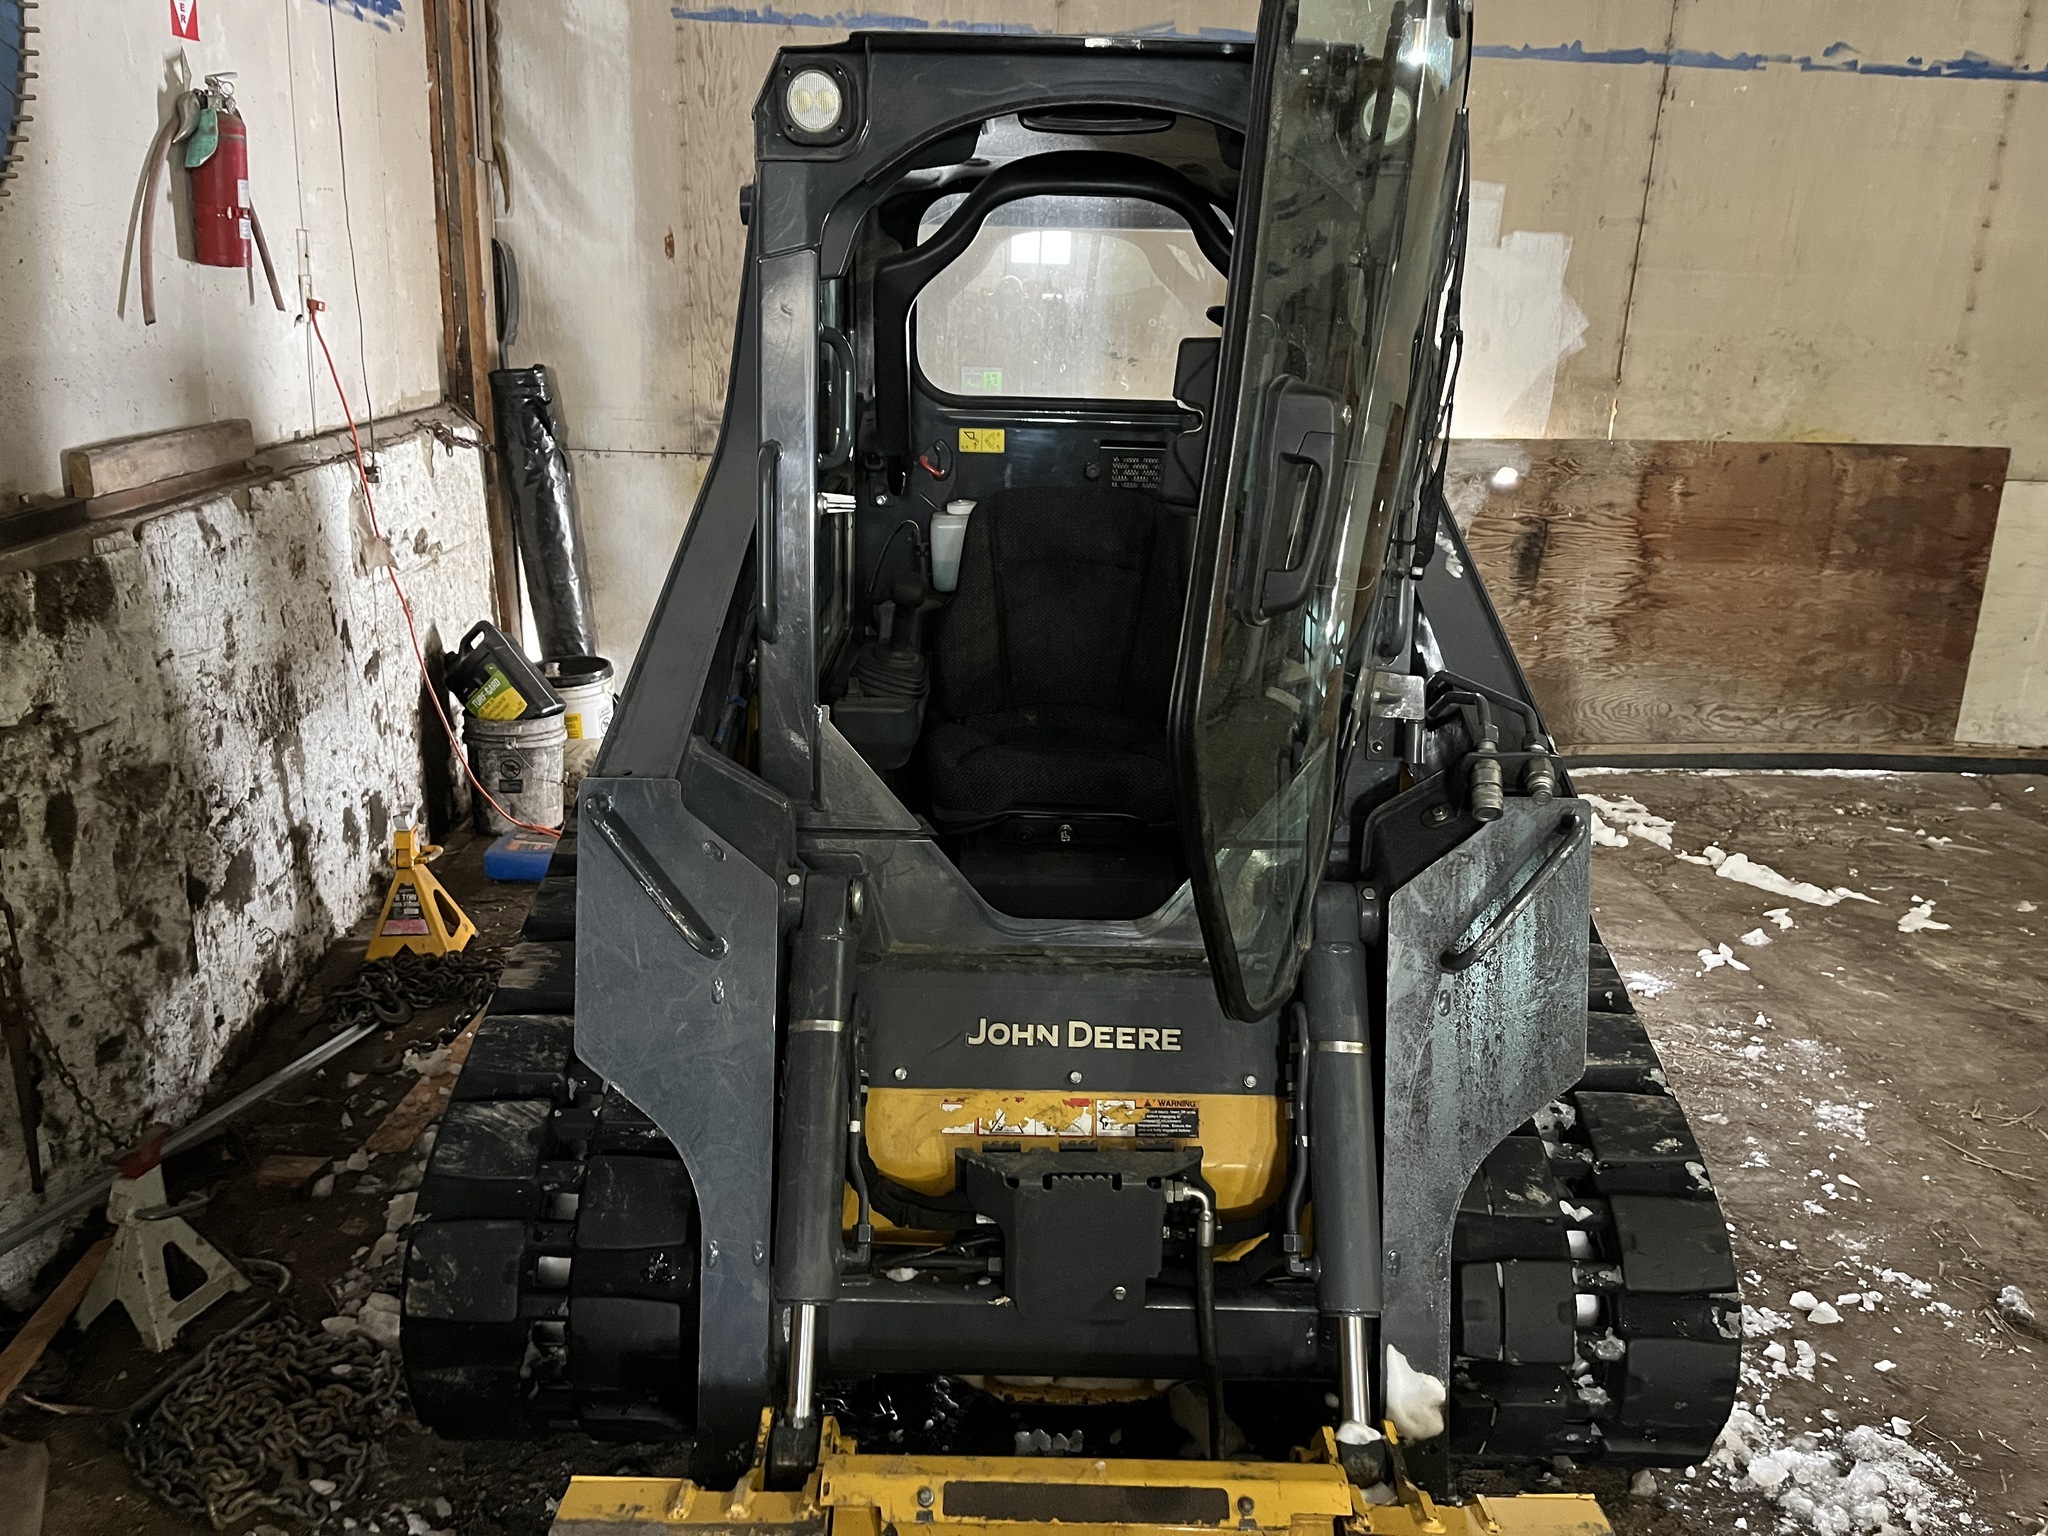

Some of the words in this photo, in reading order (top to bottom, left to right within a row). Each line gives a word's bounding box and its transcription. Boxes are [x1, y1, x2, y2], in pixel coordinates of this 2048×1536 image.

[471, 677, 501, 708] TURF-GARD
[967, 1018, 1059, 1047] JOHN
[1068, 1020, 1182, 1051] DEERE
